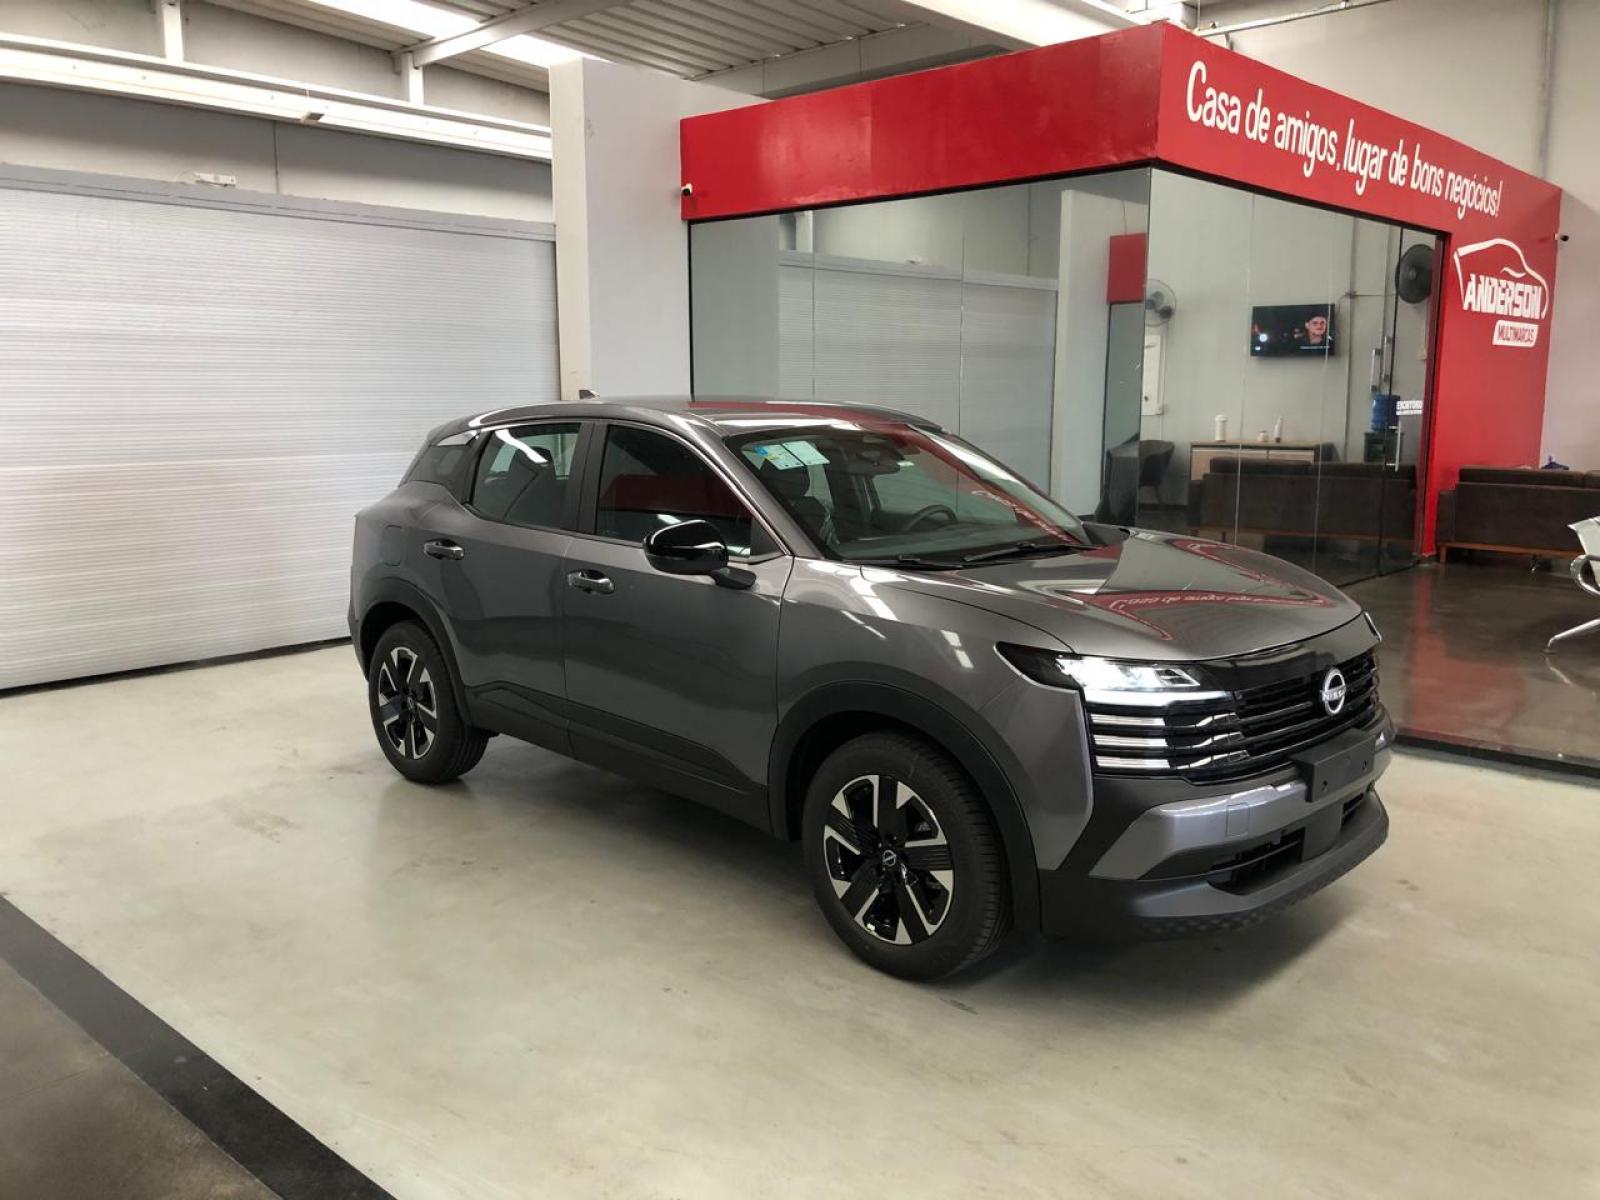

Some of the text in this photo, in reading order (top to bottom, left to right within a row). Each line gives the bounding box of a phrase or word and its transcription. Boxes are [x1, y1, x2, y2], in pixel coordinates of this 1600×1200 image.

[1186, 60, 1503, 220] Casa de amigos, lugar de bons negócios!
[1463, 273, 1542, 320] ANDERSON
